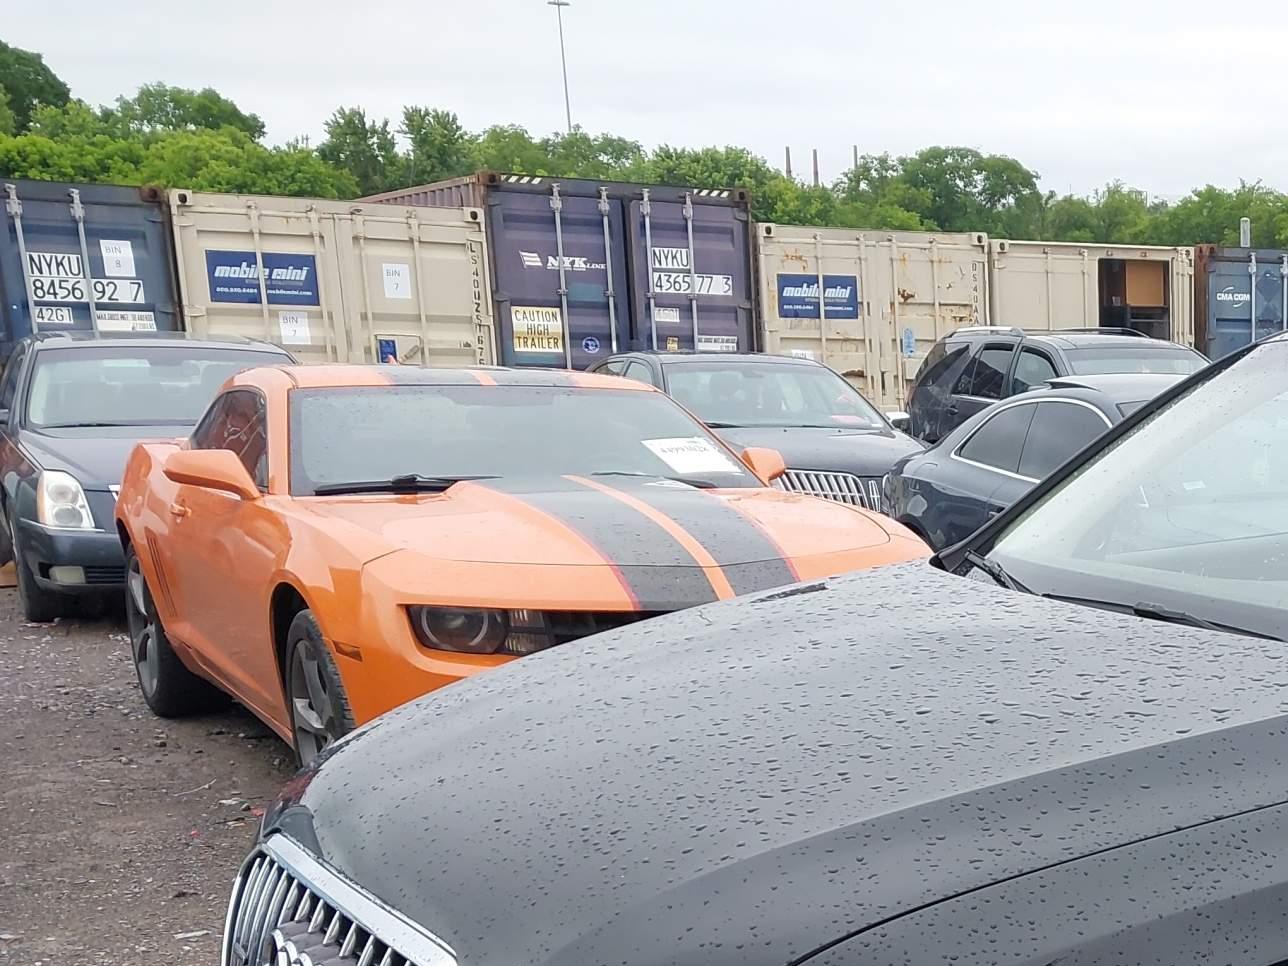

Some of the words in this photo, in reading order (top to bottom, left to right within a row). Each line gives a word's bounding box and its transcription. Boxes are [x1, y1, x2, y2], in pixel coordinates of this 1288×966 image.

[104, 245, 122, 255] BIN
[28, 253, 81, 277] NYKU
[547, 255, 588, 269] NYK
[652, 248, 690, 268] NYKU
[214, 261, 269, 279] mobile
[271, 266, 310, 281] mini
[824, 286, 853, 298] mini
[1216, 292, 1233, 301] CMA
[1234, 293, 1250, 302] CGM
[36, 307, 72, 322] 42G1
[514, 310, 559, 323] CAUTION
[526, 323, 550, 336] HIGH
[516, 336, 560, 350] TRAILER
